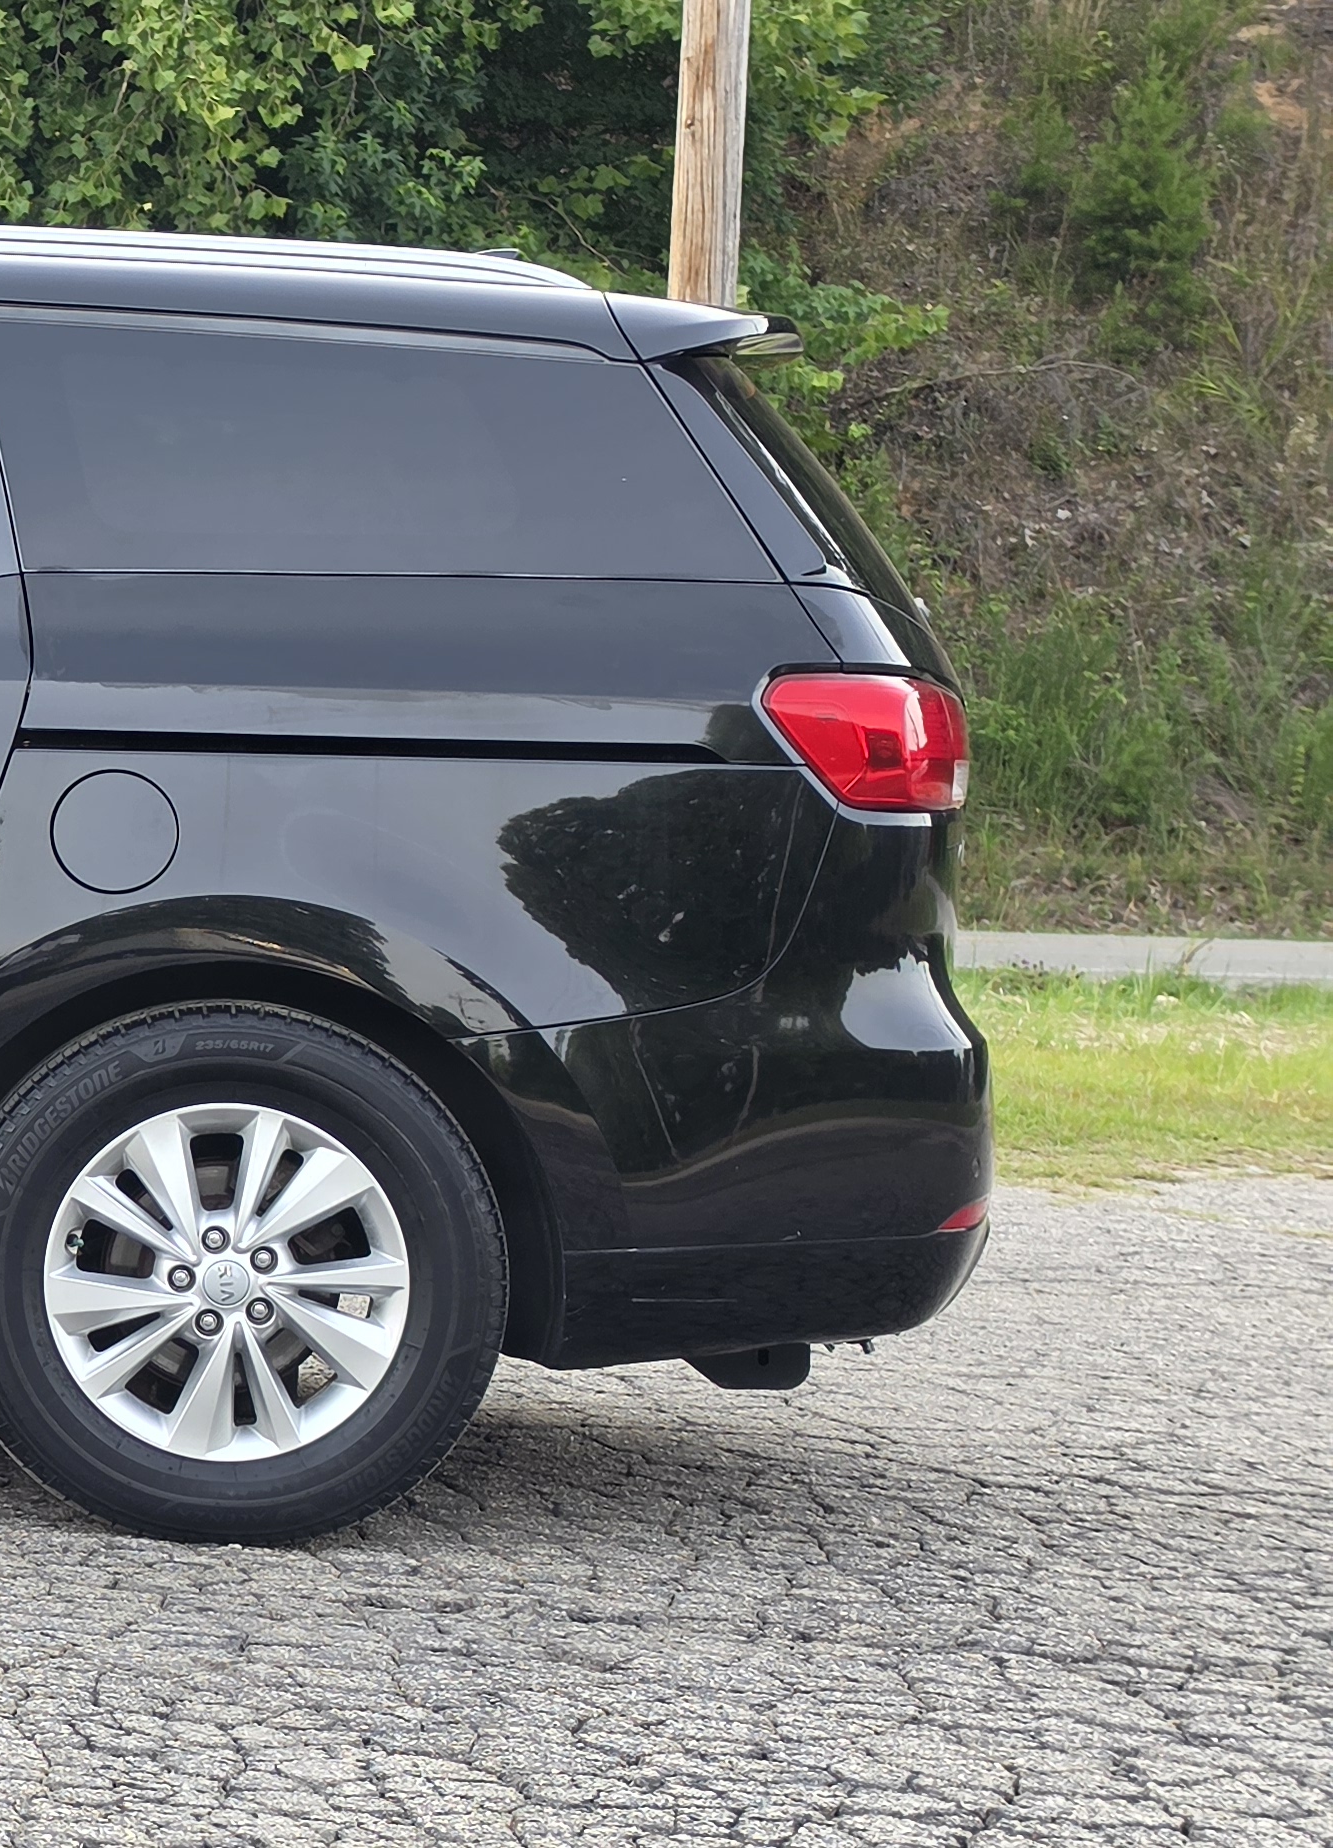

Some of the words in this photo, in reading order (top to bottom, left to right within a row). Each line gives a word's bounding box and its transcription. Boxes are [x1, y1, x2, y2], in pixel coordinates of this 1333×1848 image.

[195, 1039, 275, 1053] 235/65R17
[217, 1263, 235, 1302] KIA
[340, 1368, 461, 1500] BRIDGESTONE
